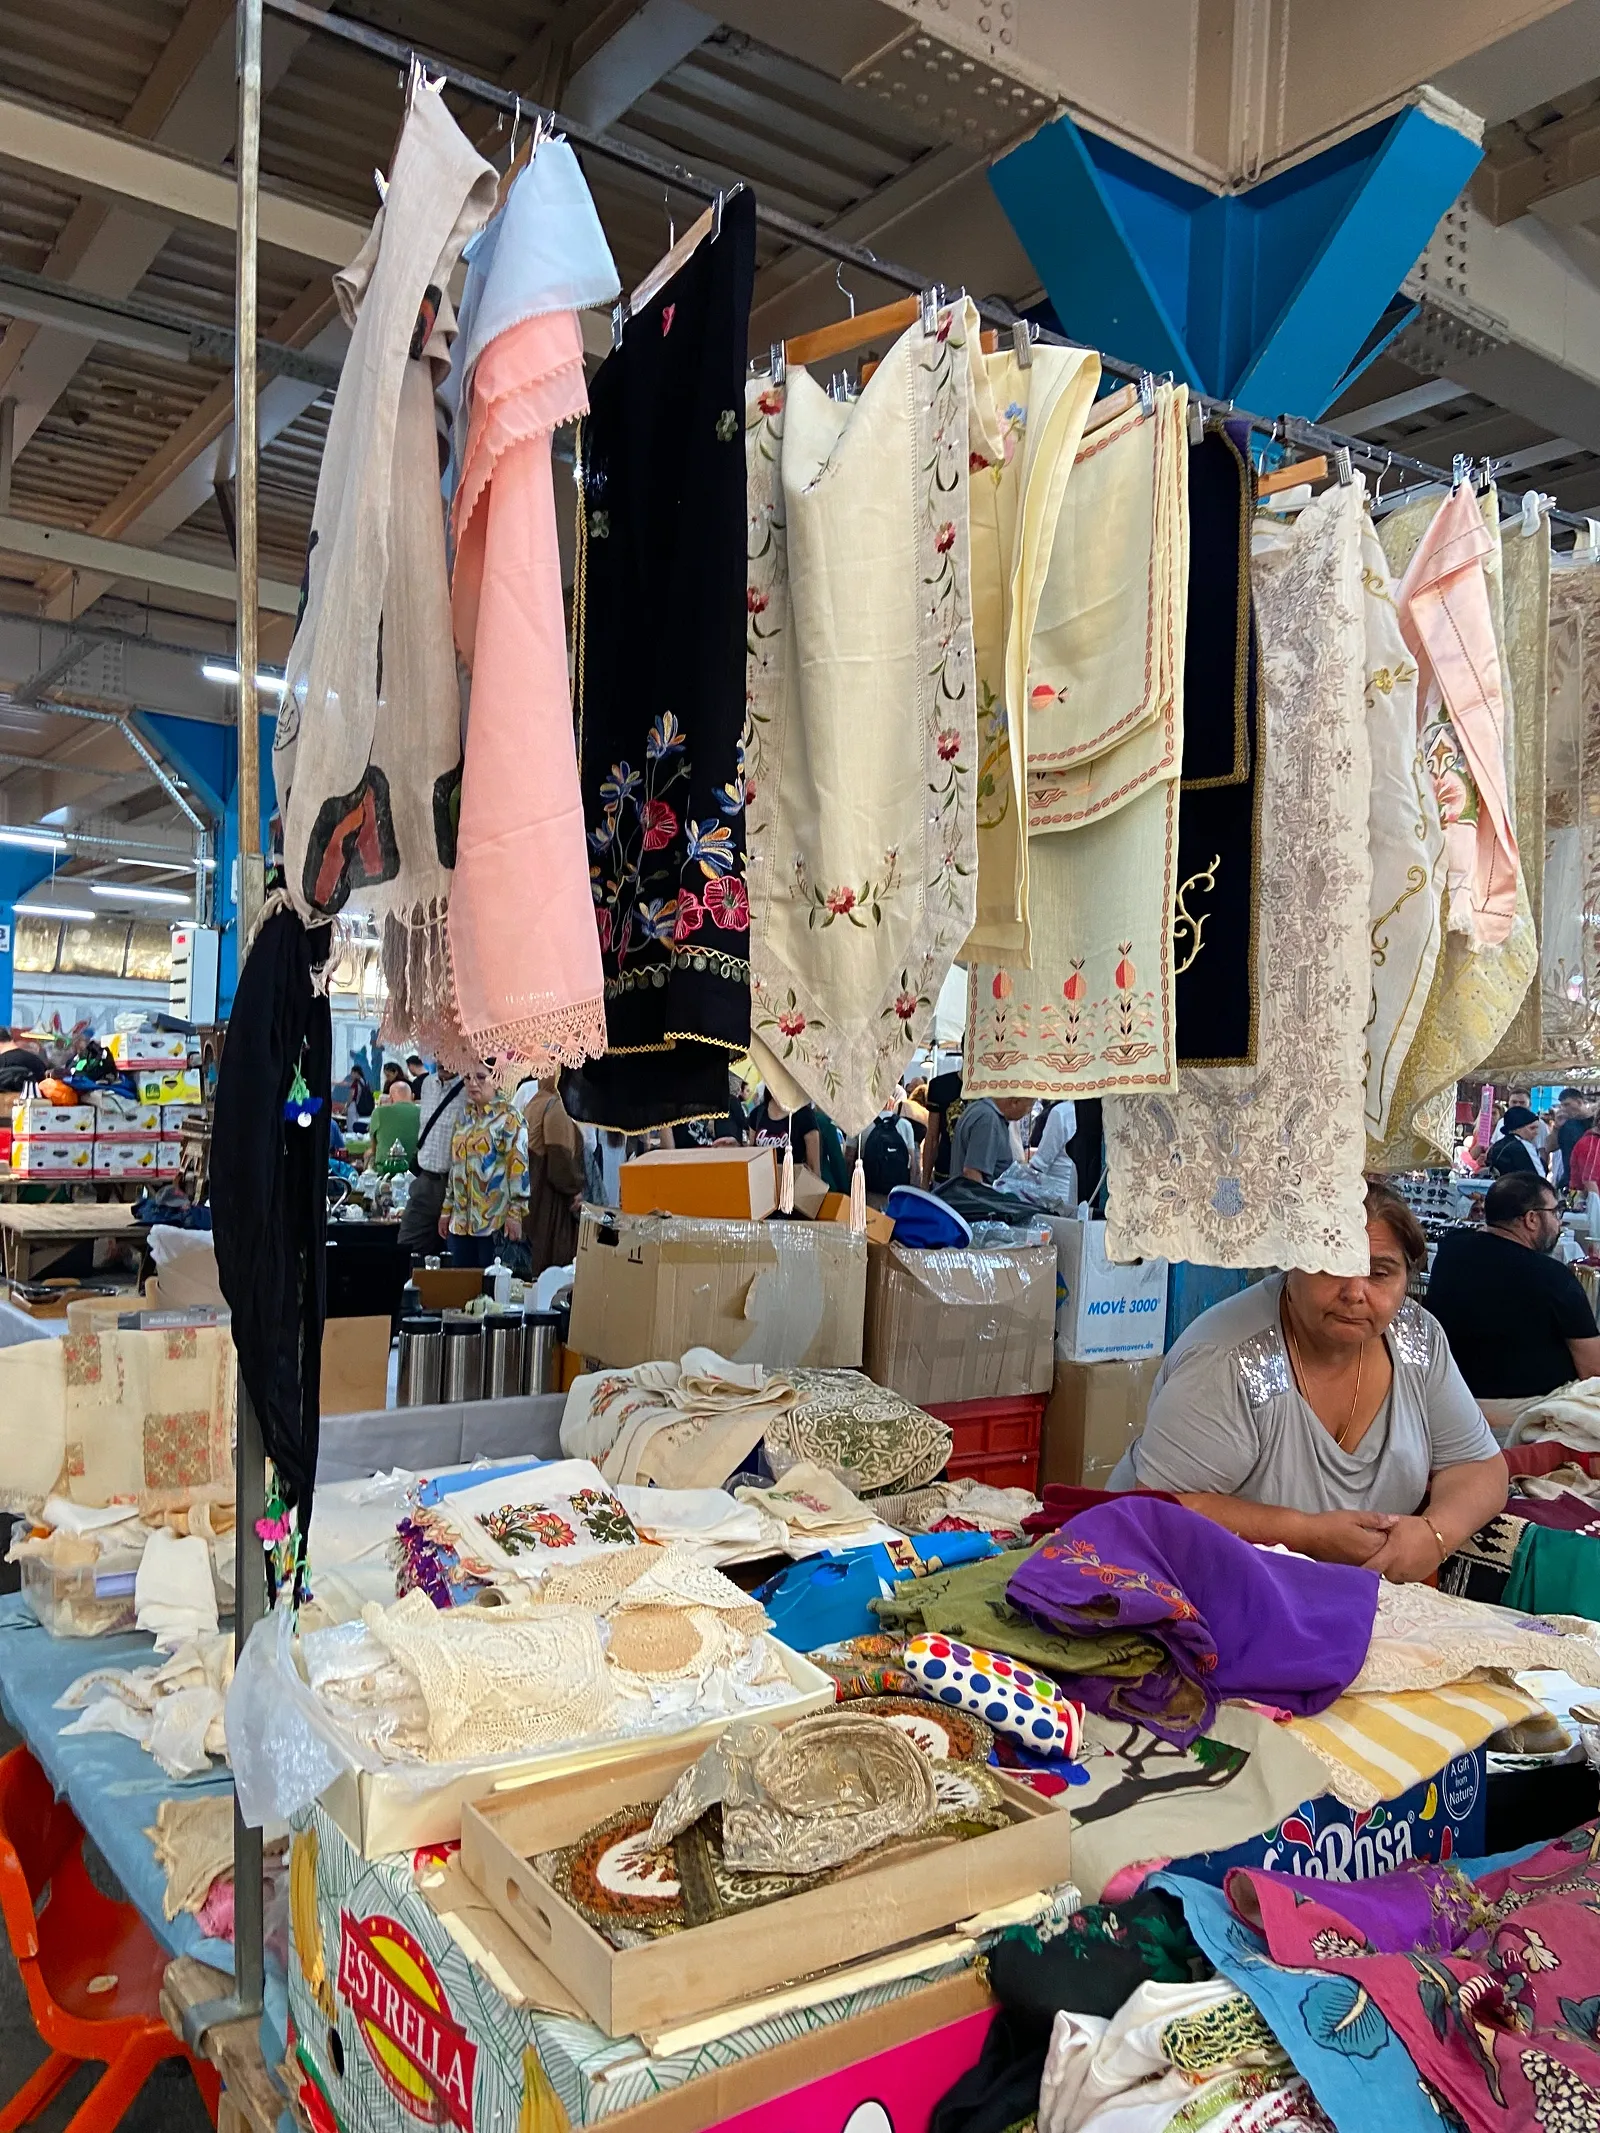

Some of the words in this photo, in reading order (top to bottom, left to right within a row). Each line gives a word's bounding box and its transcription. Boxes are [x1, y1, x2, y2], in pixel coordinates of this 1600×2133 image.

[1128, 1298, 1158, 1314] 3000
[1450, 1760, 1457, 1776] A
[1457, 1756, 1470, 1774] Gift
[1455, 1775, 1468, 1787] from
[1448, 1783, 1474, 1808] Nature
[342, 1929, 469, 2113] ESTRELLA
